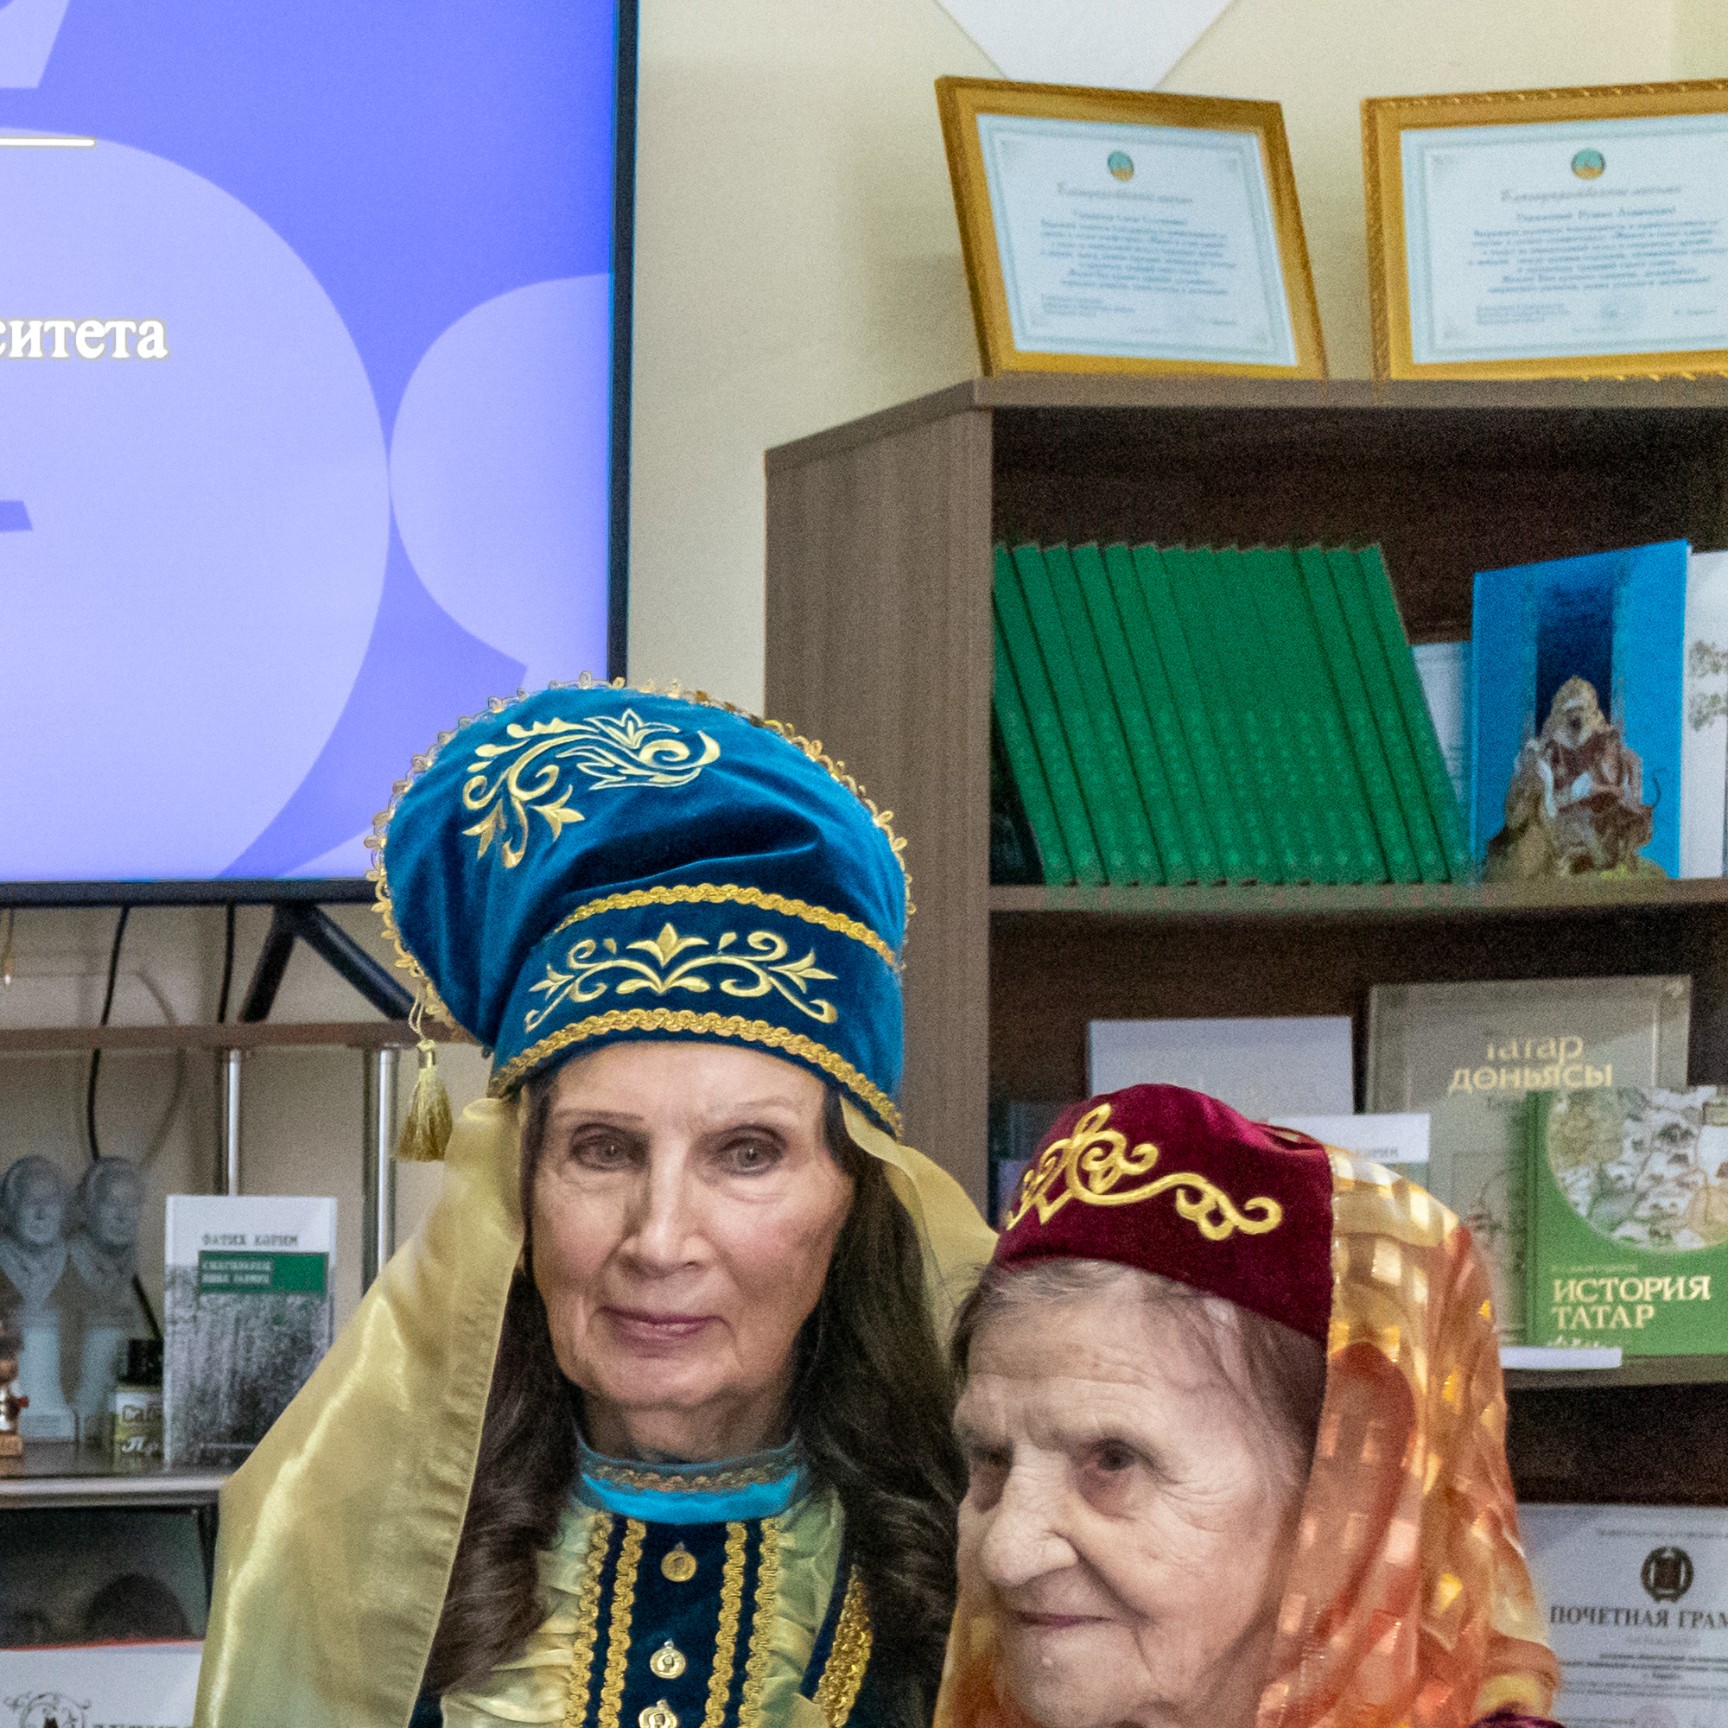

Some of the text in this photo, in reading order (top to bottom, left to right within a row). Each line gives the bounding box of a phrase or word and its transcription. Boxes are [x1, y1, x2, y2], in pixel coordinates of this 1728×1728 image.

[1552, 1274, 1712, 1303] ИСТОРИЯ
[1551, 1303, 1656, 1330] ТАТАР
[1549, 1604, 1670, 1629] ПОЧЕТНАЯ
